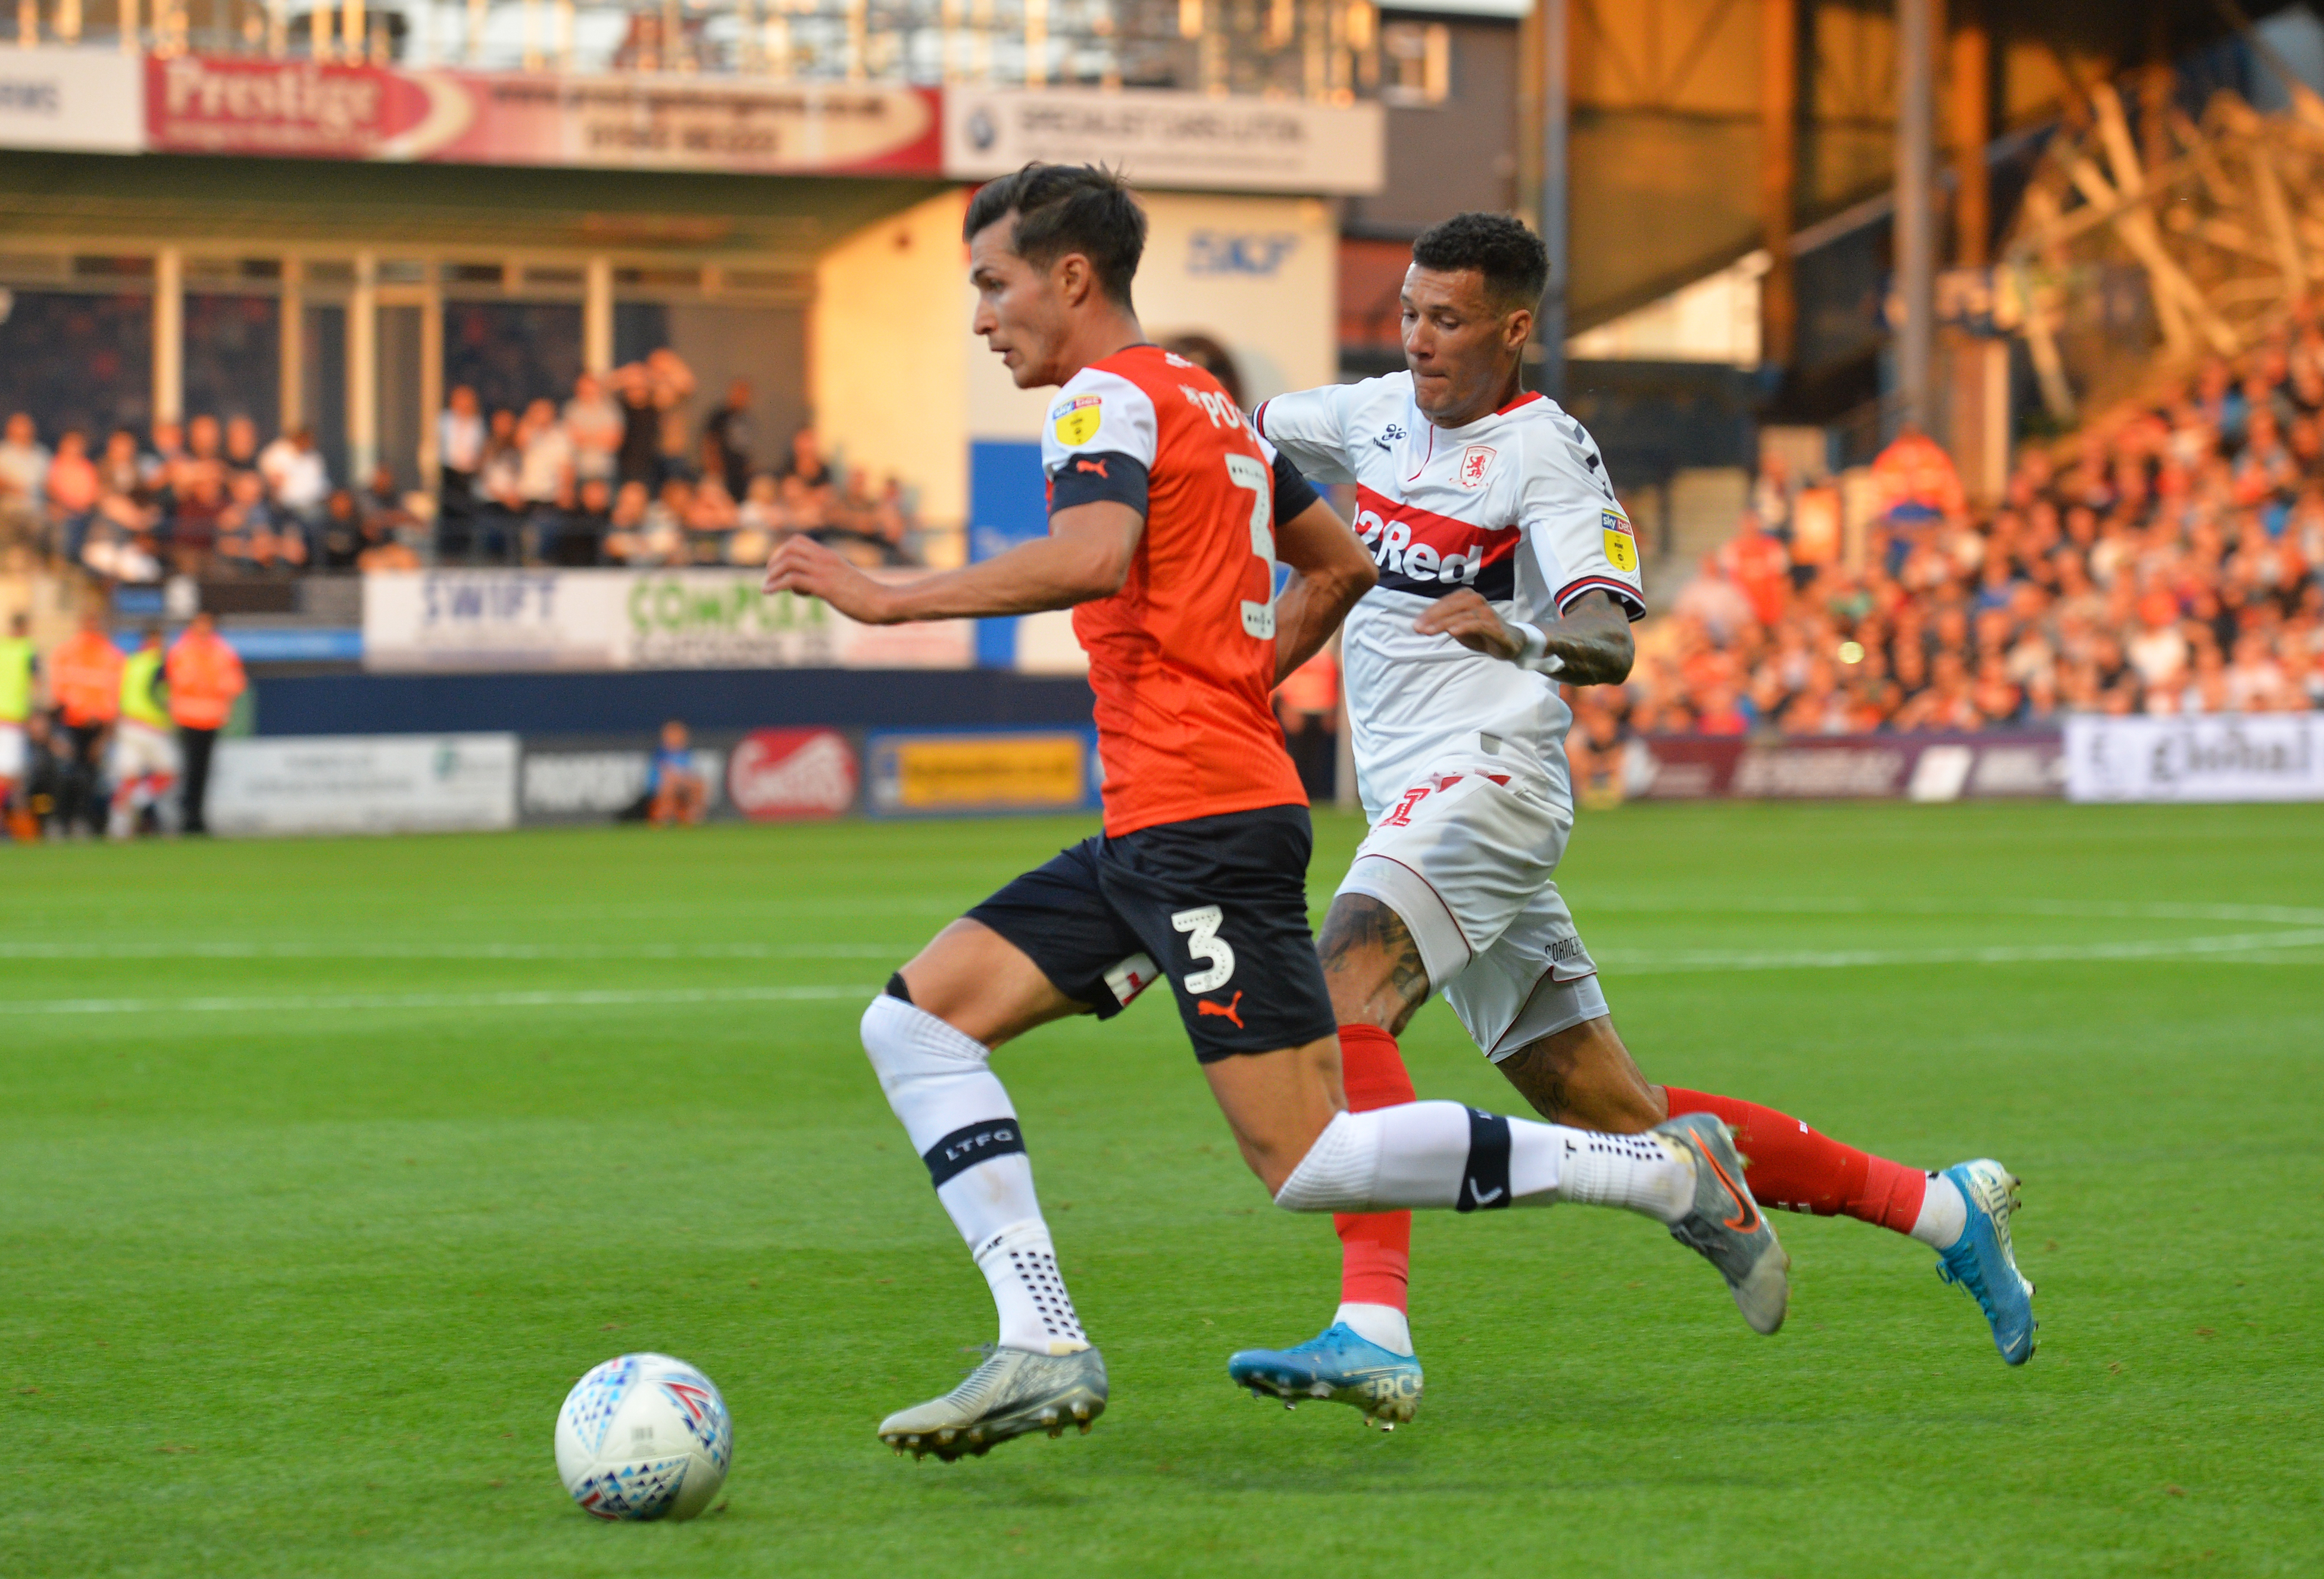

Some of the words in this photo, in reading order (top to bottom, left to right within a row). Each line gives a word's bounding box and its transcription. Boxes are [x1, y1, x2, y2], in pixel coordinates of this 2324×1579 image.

[1224, 453, 1276, 640] 3
[1352, 501, 1483, 585] 2Red
[1603, 514, 1616, 529] sky
[1617, 519, 1632, 533] bet
[1170, 904, 1236, 995] 3
